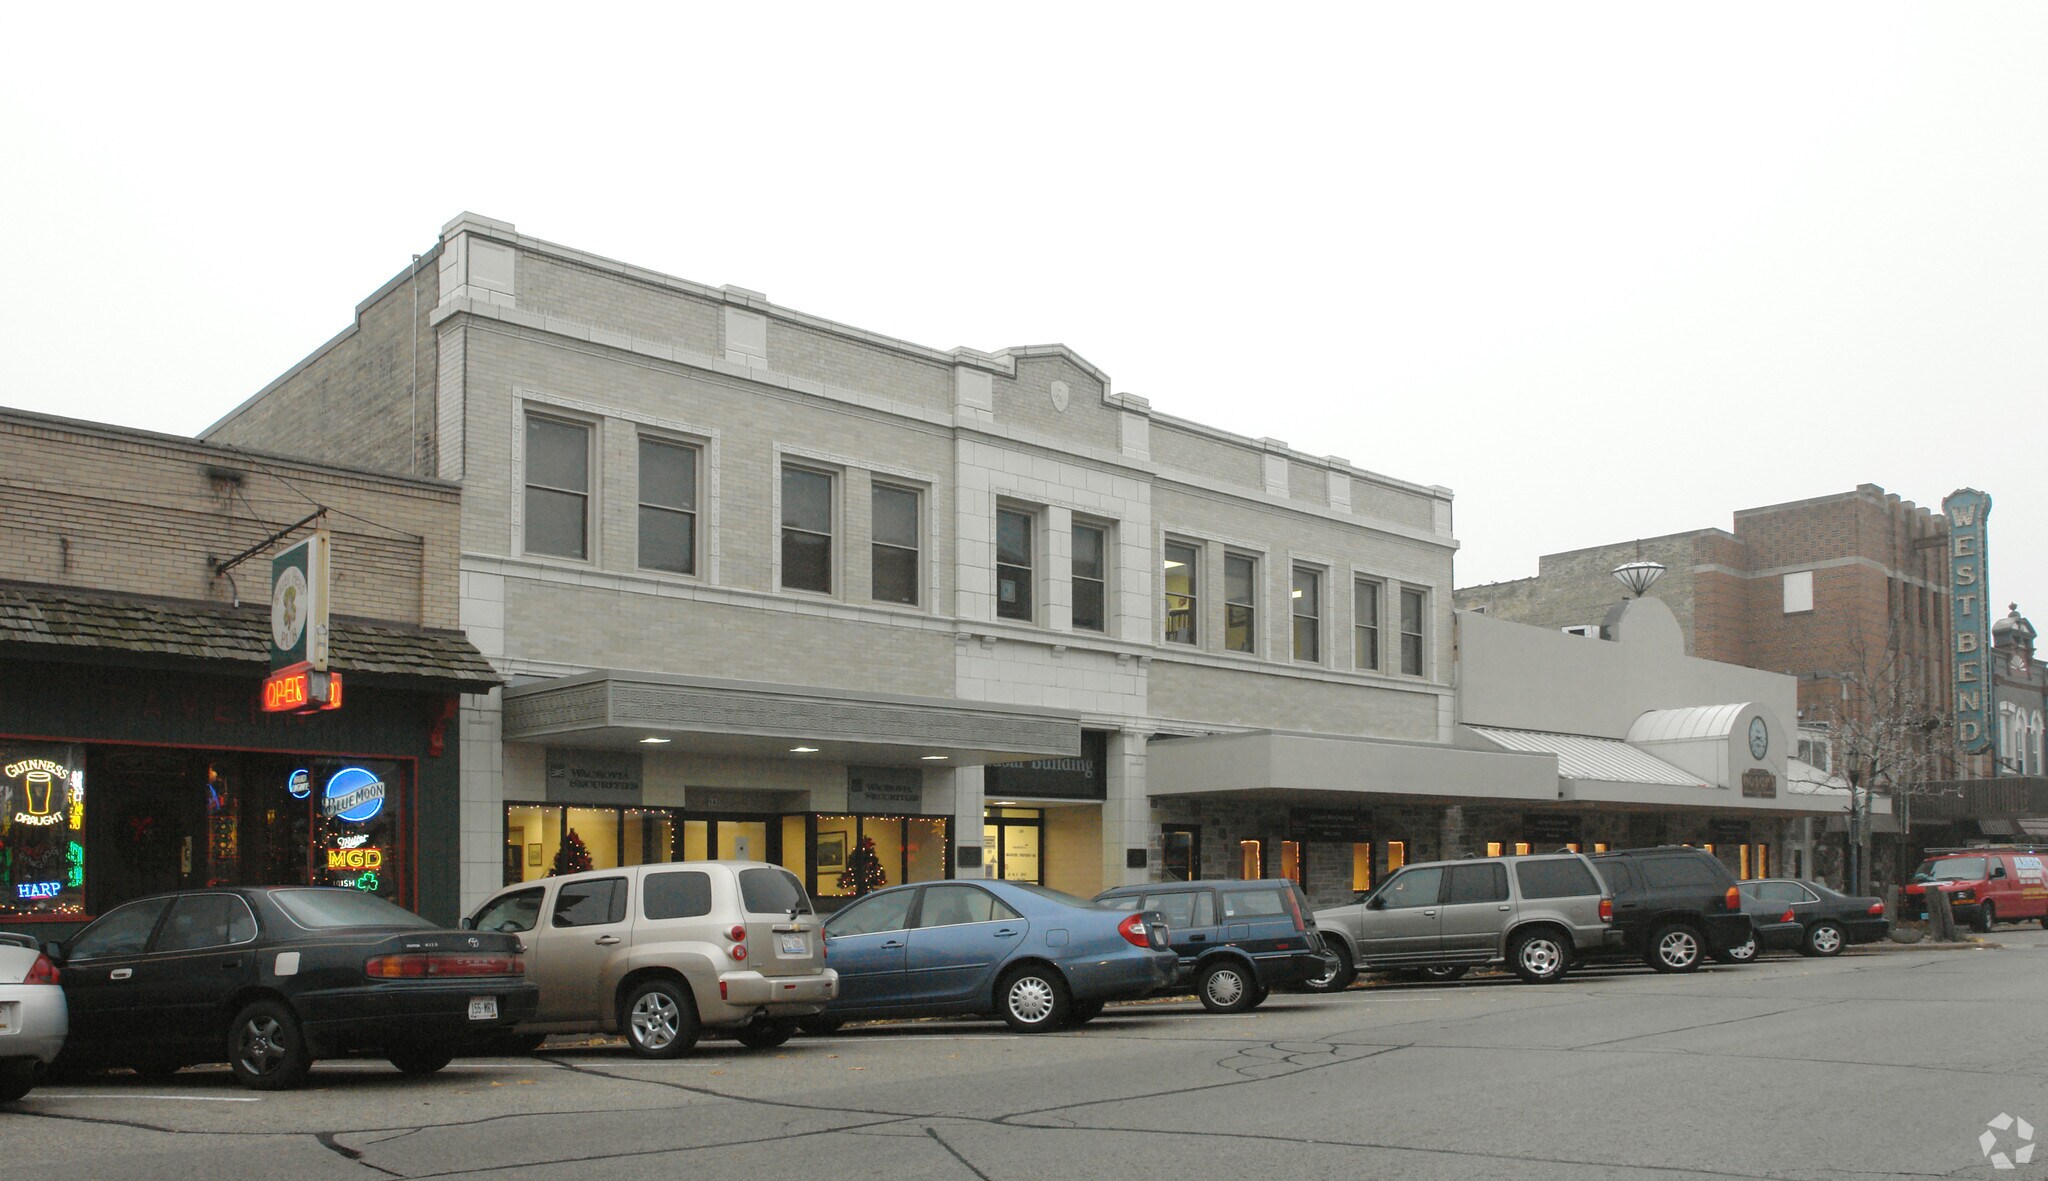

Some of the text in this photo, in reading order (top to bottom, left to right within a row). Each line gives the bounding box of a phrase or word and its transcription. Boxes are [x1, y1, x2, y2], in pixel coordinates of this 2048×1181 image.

[1950, 503, 1981, 742] WEST BEND
[280, 626, 298, 650] PUB
[266, 676, 305, 707] OPEN
[5, 759, 70, 780] GUINNESS
[322, 784, 384, 816] BLUE MOON
[15, 812, 64, 826] DRAUGHT
[337, 834, 370, 849] Miller
[328, 850, 382, 868] MGD
[18, 882, 62, 898] HARP
